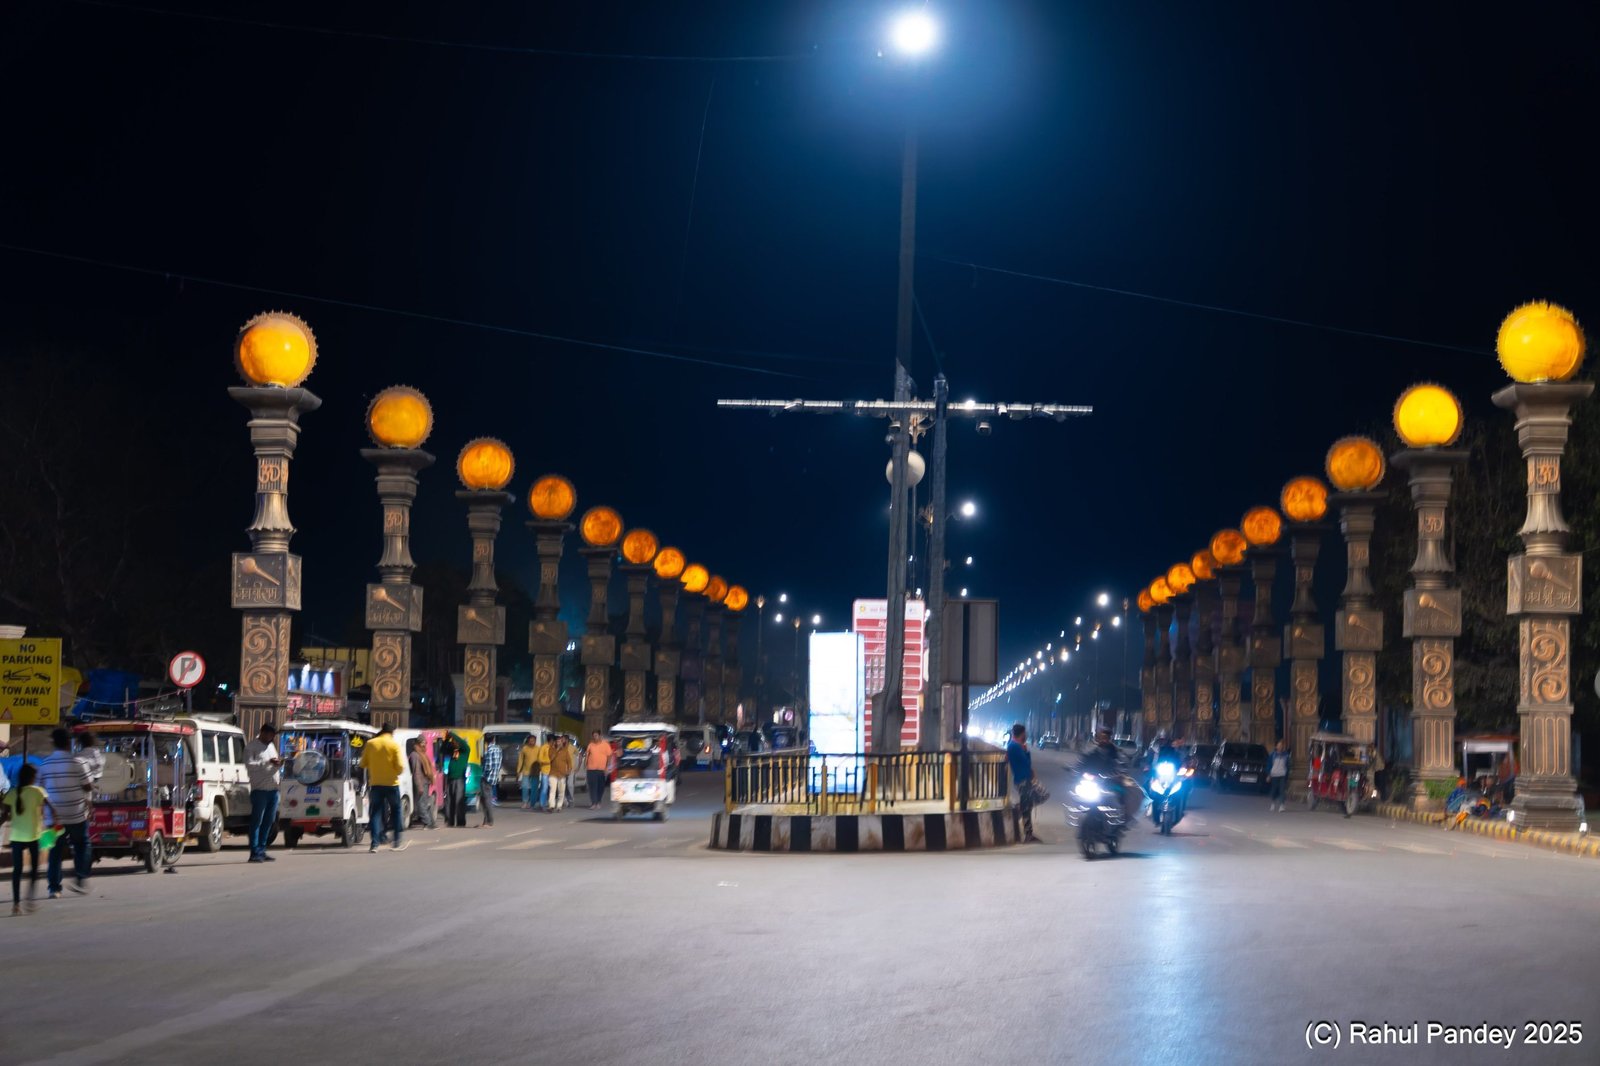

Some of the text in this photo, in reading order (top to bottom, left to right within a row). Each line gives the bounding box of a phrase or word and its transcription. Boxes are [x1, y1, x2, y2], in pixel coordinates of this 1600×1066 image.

[19, 643, 36, 653] NO
[2, 655, 53, 665] PARKING
[180, 657, 197, 678] P
[1, 686, 51, 695] TOW AWAY
[12, 697, 39, 707] ZONE
